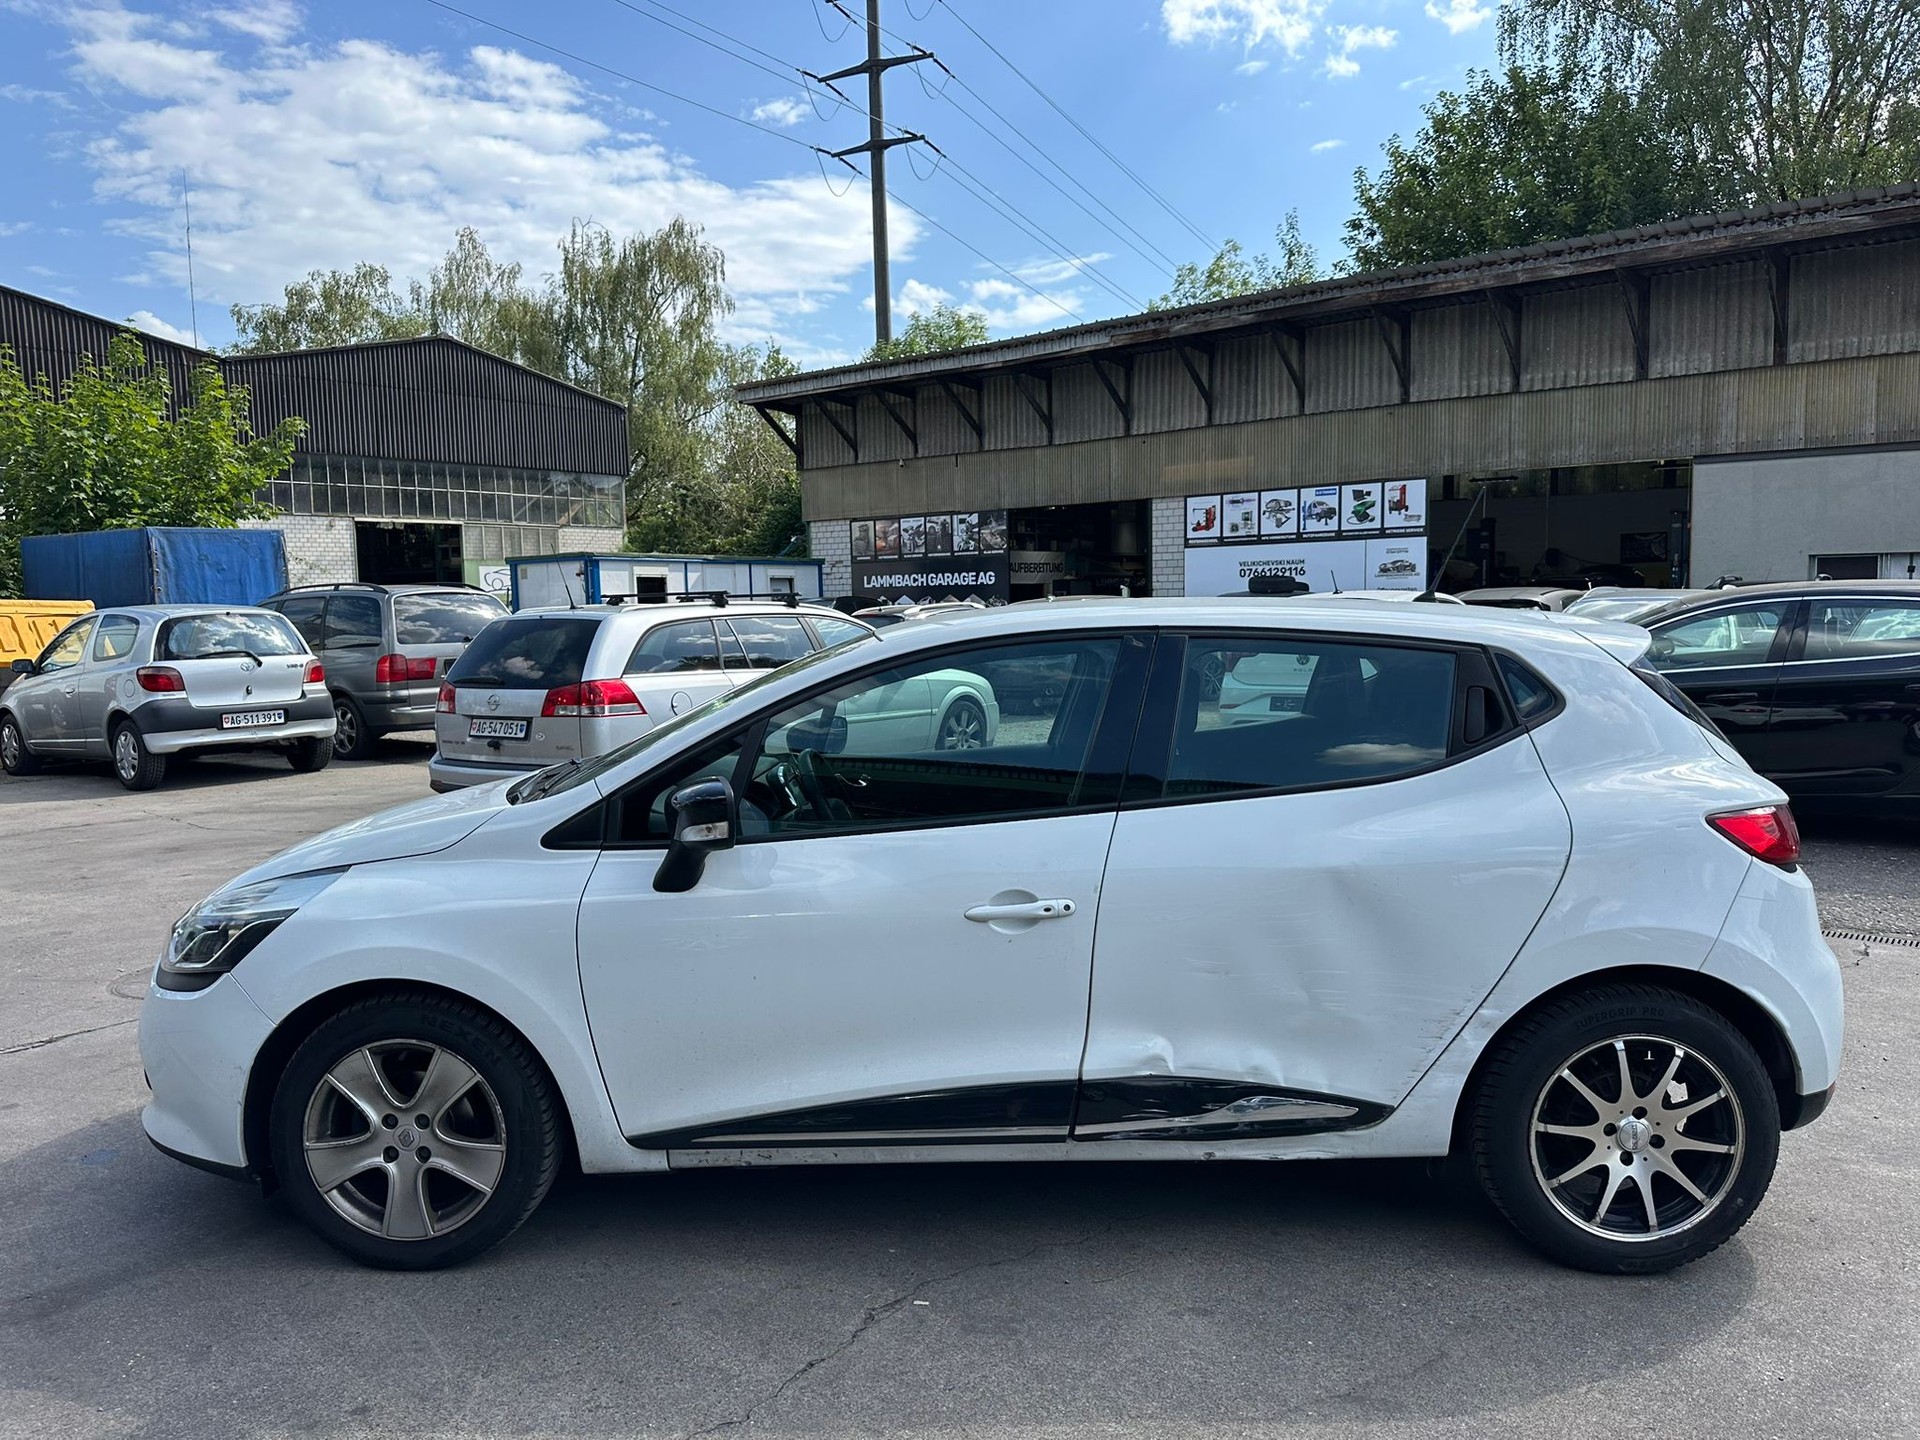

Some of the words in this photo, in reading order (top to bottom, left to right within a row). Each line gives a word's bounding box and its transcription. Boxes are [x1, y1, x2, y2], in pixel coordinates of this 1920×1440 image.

[1010, 562, 1064, 574] AUFBEREITUNG
[1239, 566, 1306, 578] 0766129116
[863, 573, 926, 588] LAMMBACH
[928, 572, 977, 586] GARAGE
[977, 571, 995, 585] AG
[1642, 1007, 1665, 1017] PRO
